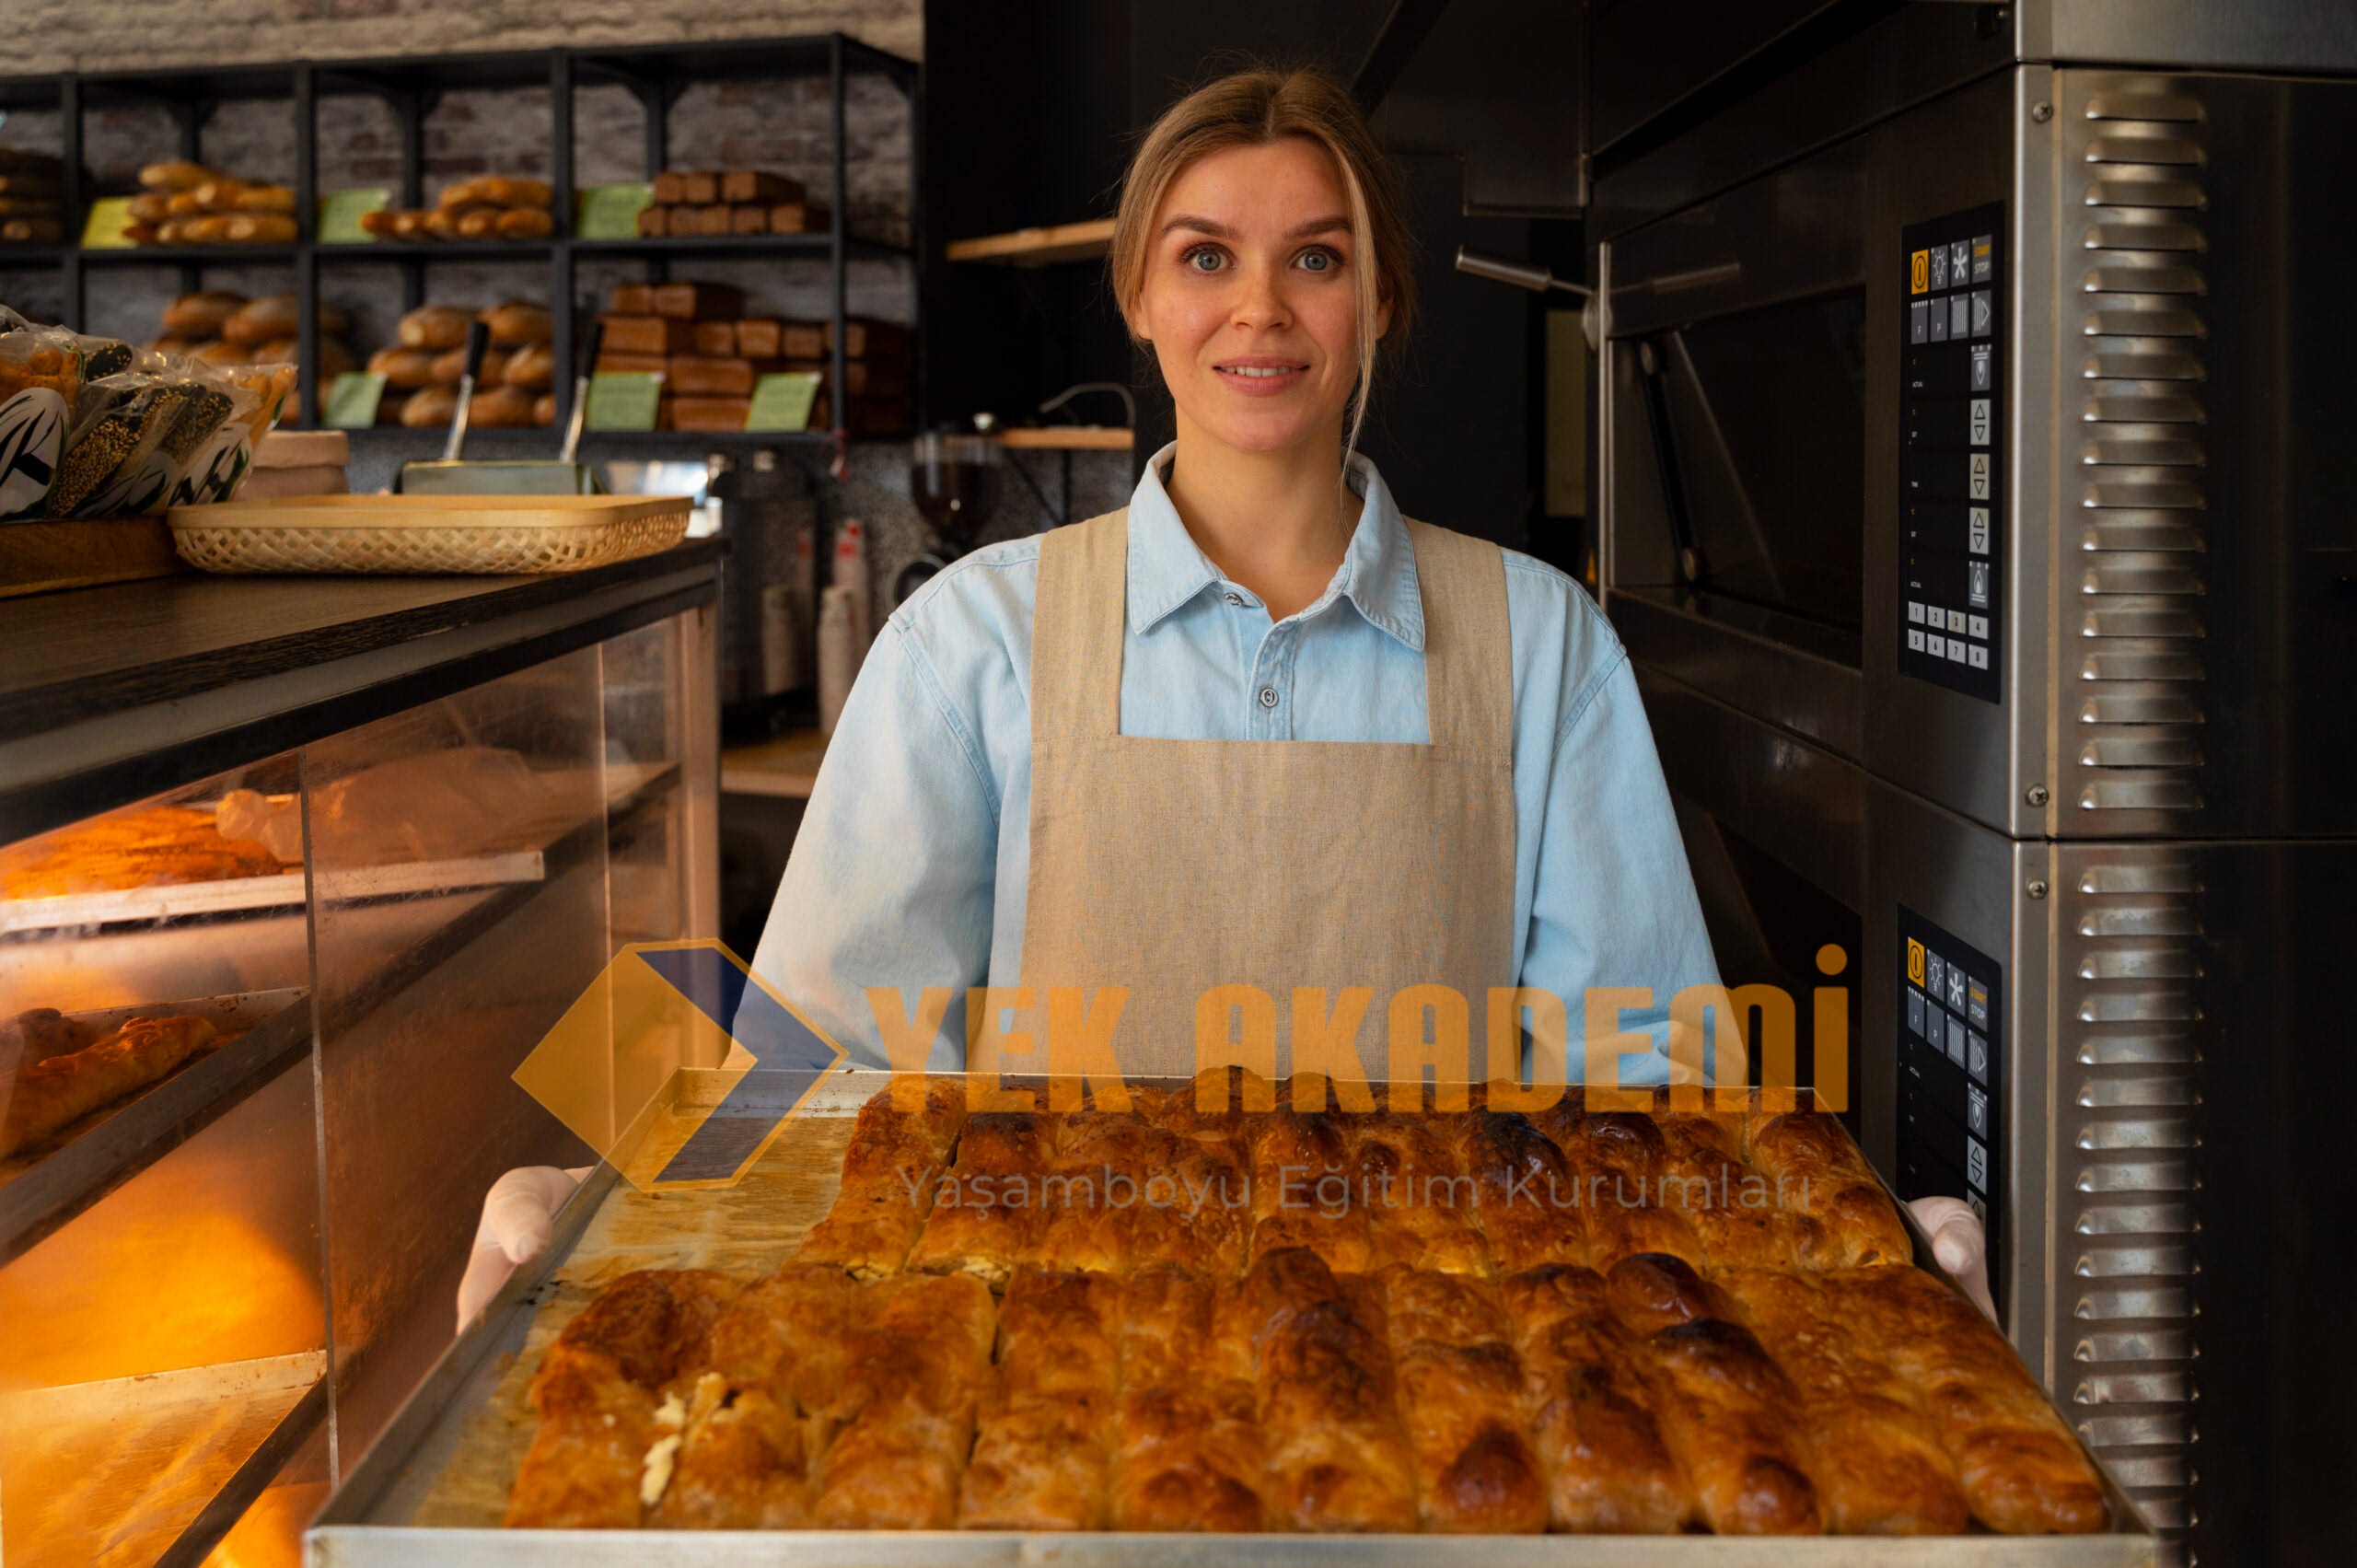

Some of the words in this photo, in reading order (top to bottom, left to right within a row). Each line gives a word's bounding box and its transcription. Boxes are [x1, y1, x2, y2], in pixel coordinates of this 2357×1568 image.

[1974, 244, 1991, 258] START
[1975, 261, 1990, 274] STOP
[1933, 611, 1938, 622] 2
[1954, 617, 1958, 627] 3
[1976, 621, 1980, 632] 4
[1914, 635, 1919, 645] 5
[1933, 641, 1938, 651] 6
[1954, 646, 1958, 656] 7
[1976, 652, 1980, 662] 8
[1970, 987, 1987, 1005] START
[1971, 1004, 1985, 1020] STOP
